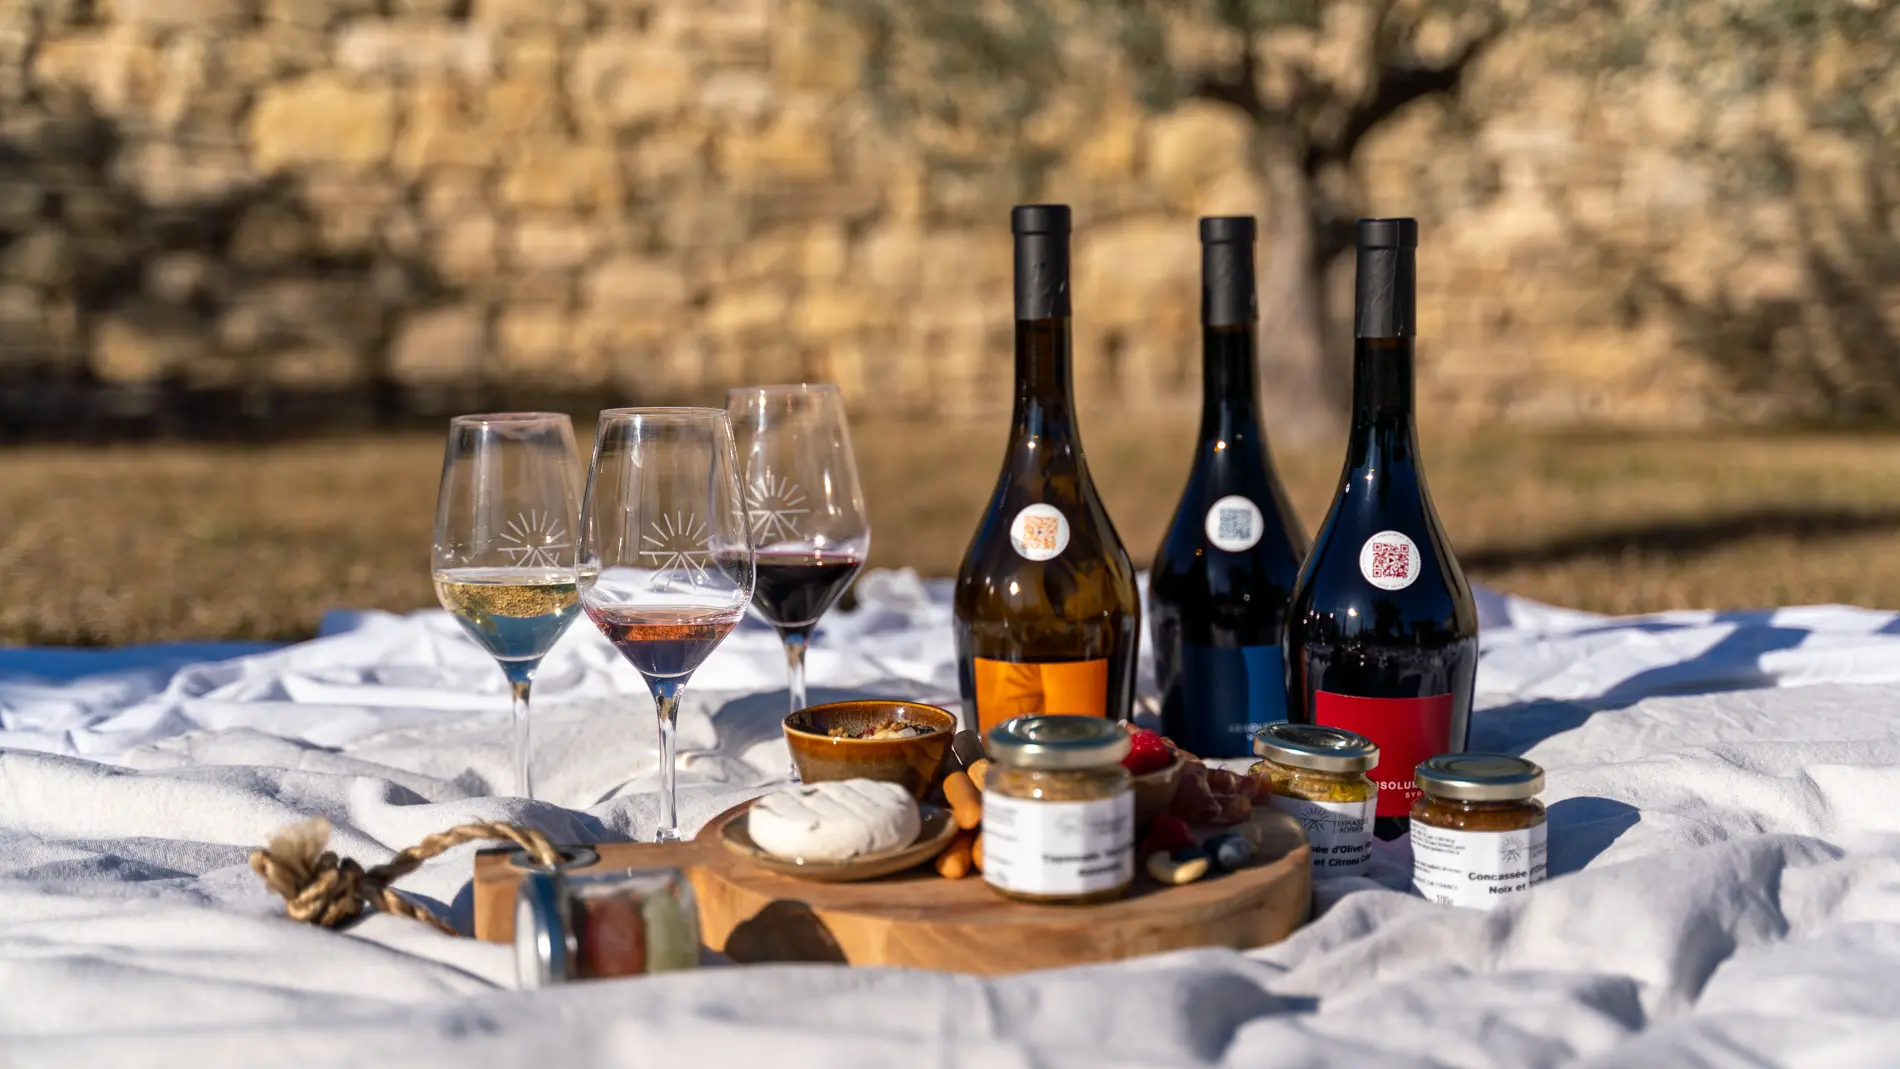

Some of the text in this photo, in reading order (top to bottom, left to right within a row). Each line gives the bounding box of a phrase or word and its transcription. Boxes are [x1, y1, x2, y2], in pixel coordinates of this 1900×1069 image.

[1468, 870, 1527, 881] Concassée
[1489, 882, 1526, 894] Noix et
